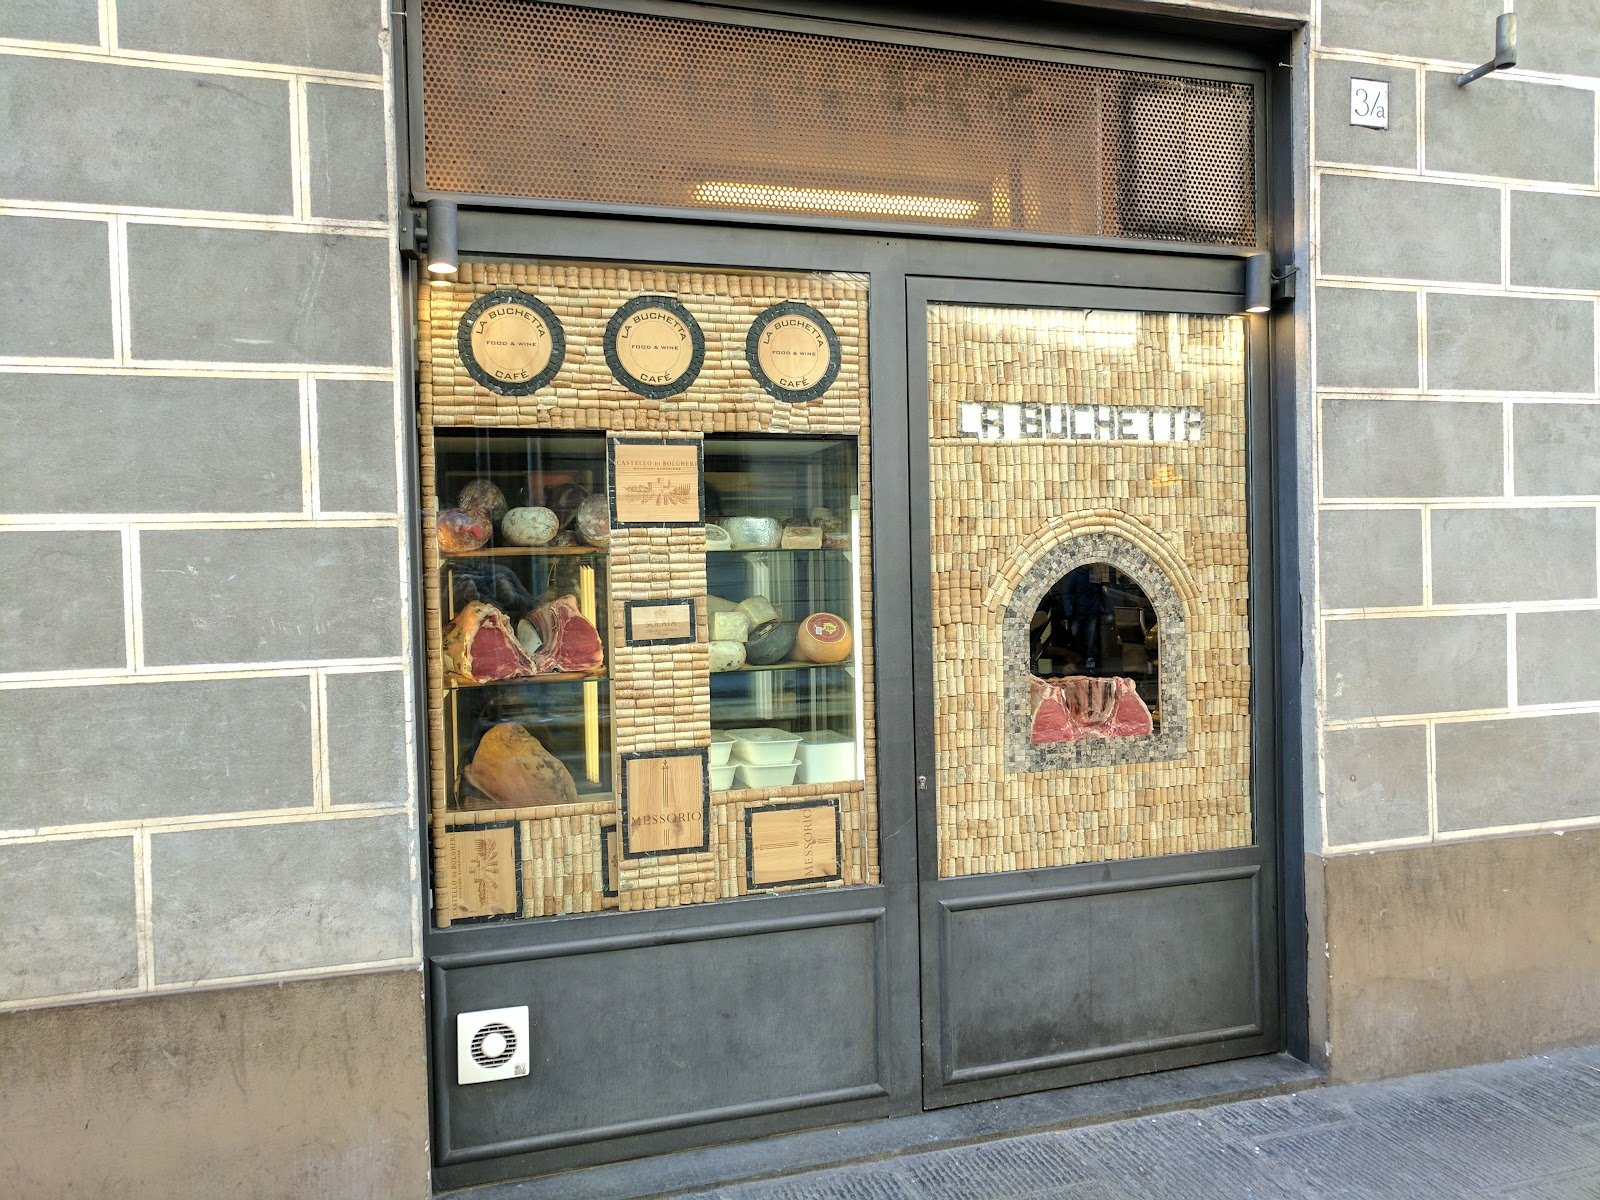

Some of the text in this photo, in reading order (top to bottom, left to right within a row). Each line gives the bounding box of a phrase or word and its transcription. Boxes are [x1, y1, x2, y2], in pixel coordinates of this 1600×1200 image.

[1354, 88, 1386, 119] 3/a
[476, 307, 546, 338] LA BUCHETTA
[621, 312, 687, 341] LA BUCHETTA
[763, 319, 824, 347] LA BUCHETTA
[495, 368, 529, 380] CAFÉ
[640, 371, 672, 383] CAFÉ
[779, 376, 810, 388] CAFÉ
[957, 400, 1004, 440] LA
[631, 811, 702, 827] MESSORIO
[803, 809, 814, 877] MESSORIO
